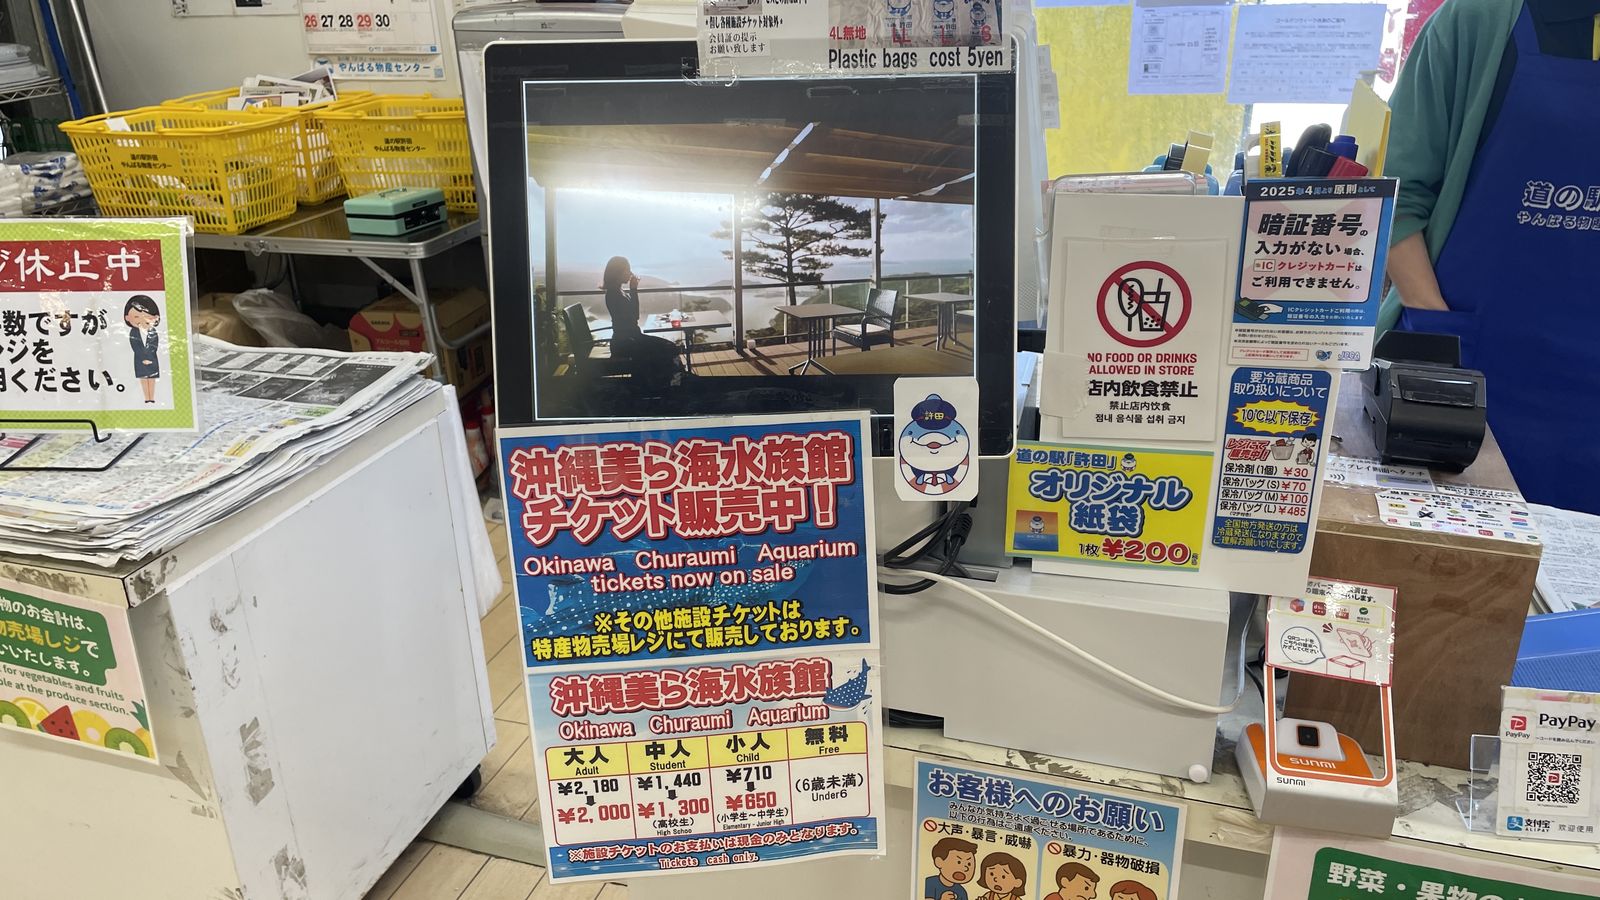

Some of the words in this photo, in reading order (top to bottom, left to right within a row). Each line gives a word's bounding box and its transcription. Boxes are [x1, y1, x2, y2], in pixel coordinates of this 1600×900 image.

[305, 15, 318, 27] 26
[321, 15, 334, 27] 27
[339, 15, 353, 28] 28
[357, 14, 371, 27] 29
[375, 14, 390, 27] 30
[829, 25, 867, 40] 4L無地
[338, 63, 432, 73] やんばる物産センター
[828, 49, 877, 69] Plastic
[883, 48, 917, 69] bags
[930, 49, 961, 67] cost
[967, 48, 1003, 68] 5yen
[1257, 213, 1368, 237] 暗証番号の
[0, 247, 141, 282] 休止中
[1251, 276, 1361, 290] ご利用できません。
[0, 309, 108, 337] 数ですが
[0, 338, 54, 364] ジを
[1087, 352, 1103, 363] NO
[1105, 352, 1134, 363] FOOD
[1137, 353, 1152, 363] OR
[1156, 353, 1197, 364] DRINKS
[1089, 365, 1140, 375] ALLOWED
[1144, 365, 1155, 375] IN
[1158, 365, 1195, 376] STORE
[1250, 371, 1313, 386] 要冷蔵商品
[1088, 379, 1198, 398] 店内飲食禁止
[1233, 383, 1328, 399] 取り扱いについて
[1095, 413, 1113, 423] 점내
[1116, 414, 1143, 424] 음식물
[1146, 414, 1164, 424] 섭취
[1168, 415, 1186, 425] 금지
[510, 432, 854, 498] 沖縄美ら海水族館
[1016, 448, 1117, 471] 道の駅「許田」
[1283, 467, 1309, 478] ¥30
[1029, 468, 1192, 511] オリジナル
[1281, 481, 1307, 491] ¥70
[1280, 493, 1308, 504] ¥100
[1070, 501, 1144, 536] 紙袋
[1278, 506, 1307, 517] ¥485
[523, 555, 614, 577] Okinawa
[635, 546, 736, 571] Churaumi
[758, 540, 857, 566] Aquarium
[1079, 543, 1100, 557] 1枚
[1102, 537, 1192, 565] ¥200
[591, 573, 665, 593] tickets
[671, 573, 714, 589] now
[720, 570, 746, 585] on
[752, 564, 794, 583] sale
[532, 617, 861, 661] 特産物売場レジにて販売しております。
[3, 665, 17, 675] for
[20, 669, 73, 689] vegetables
[75, 682, 94, 694] and
[96, 686, 125, 702] fruits
[550, 658, 832, 716] 沖縄美ら海水族館
[15, 681, 26, 691] at
[27, 683, 44, 695] the
[46, 688, 87, 705] produce
[89, 699, 129, 716] section.
[559, 720, 635, 741] Okinawa
[649, 709, 733, 734] Churaumi
[747, 702, 830, 727] Aquarium
[1539, 713, 1597, 731] PayPay
[726, 732, 771, 752] 小人
[804, 725, 849, 746] 無料
[1505, 731, 1531, 739] PayPay
[564, 745, 609, 766] 大人
[645, 740, 691, 760] 中人
[736, 752, 760, 763] Child
[818, 744, 840, 755] Free
[575, 764, 599, 776] Adult
[649, 758, 687, 771] Student
[726, 765, 772, 783] ¥710
[725, 791, 777, 811] ¥650
[811, 788, 848, 802] Under6
[927, 768, 1166, 834] お客様へのお願い
[722, 822, 751, 831] Elementary
[756, 819, 773, 828] Junior
[1524, 818, 1551, 829] 支付宝
[1558, 823, 1594, 833] 欢迎使用
[568, 822, 859, 862] ※施設チケットのお支払いは現金のみとなります。
[937, 821, 1032, 851] 大声・暴言・威嚇
[659, 857, 699, 869] Tickets
[706, 854, 730, 865] cash
[732, 851, 759, 864] only.
[1062, 843, 1161, 876] 暴力・器物破損
